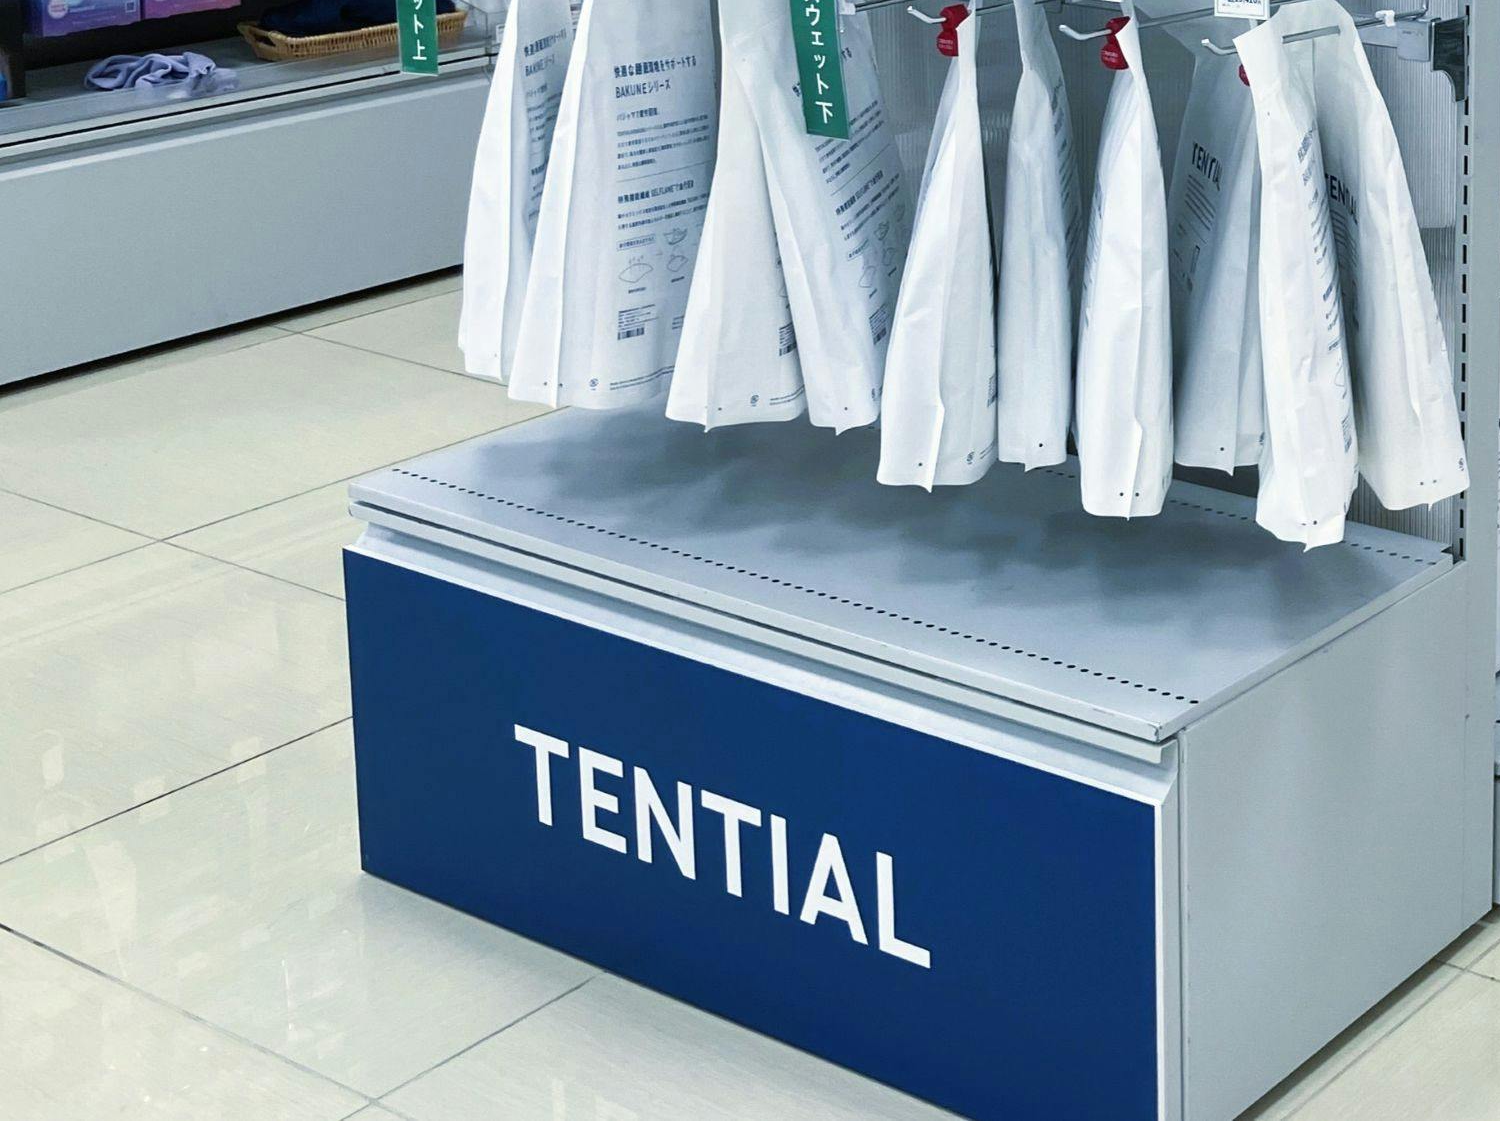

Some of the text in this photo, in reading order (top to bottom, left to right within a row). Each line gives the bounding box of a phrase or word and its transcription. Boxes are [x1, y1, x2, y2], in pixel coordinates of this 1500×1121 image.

[615, 79, 672, 99] BAKUNEシリーズ
[514, 723, 931, 969] TENTIAL
